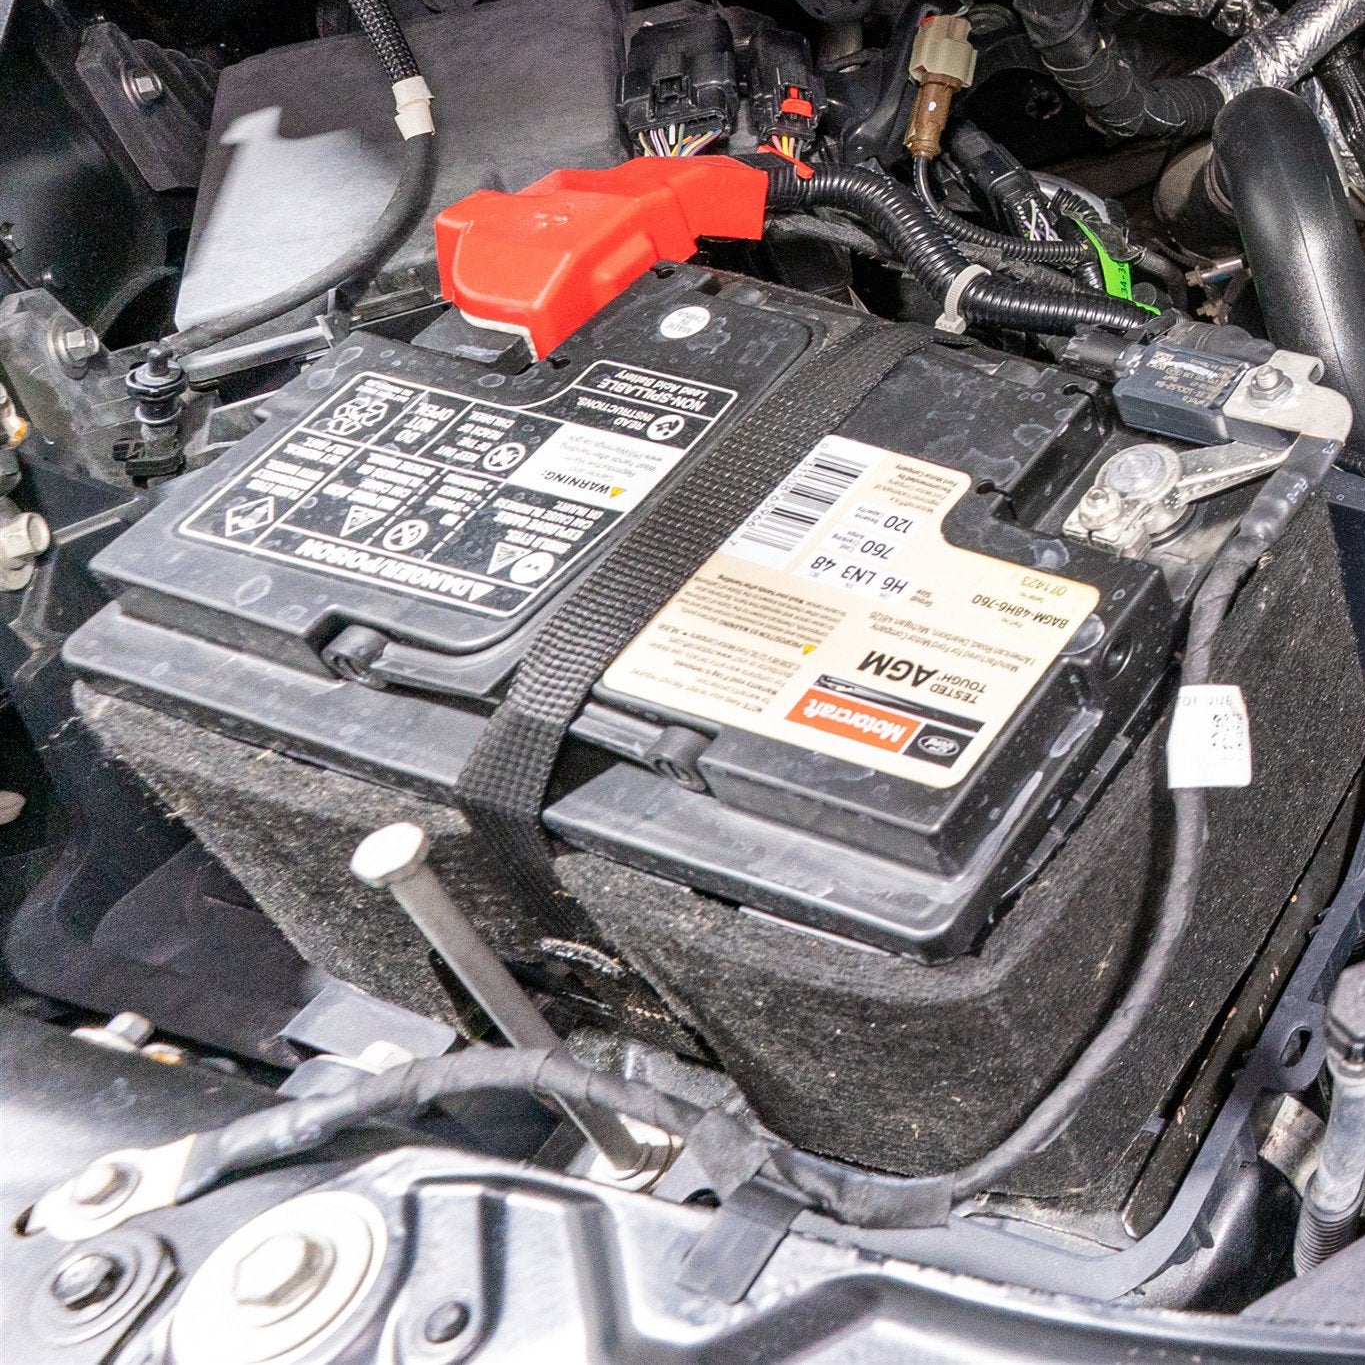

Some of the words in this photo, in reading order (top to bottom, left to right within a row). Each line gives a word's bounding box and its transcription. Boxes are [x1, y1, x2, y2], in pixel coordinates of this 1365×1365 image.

[613, 369, 658, 386] Battery
[596, 378, 706, 411] NON-SPILLABLE
[654, 381, 681, 392] Acid
[678, 387, 709, 399] Lead
[411, 402, 456, 421] OPEN.
[574, 397, 655, 421] INSTRUCTIONS.
[403, 416, 439, 432] NOT
[457, 423, 475, 432] OF
[466, 411, 516, 428] CHILDREN.
[612, 417, 646, 430] READ
[393, 429, 422, 443] DO
[469, 426, 505, 440] REACH
[433, 445, 458, 456] OUT
[456, 437, 479, 447] THE
[475, 442, 493, 451] OF
[453, 450, 481, 462] KEEP
[538, 471, 611, 493] WARNING:
[492, 498, 546, 517] BLINDNESS
[551, 501, 590, 516] INJURY.
[586, 510, 604, 519] OR
[493, 511, 532, 527] GASES
[541, 511, 575, 524] CAUSE
[571, 518, 595, 529] CAN
[881, 513, 915, 534] 120
[501, 530, 537, 545] EYES.
[524, 519, 585, 540] EXPLOSIVE
[530, 537, 572, 554] SHIELD
[857, 538, 896, 559] 760
[293, 539, 477, 596] DANGER/POISON
[808, 554, 839, 573] 48
[838, 564, 877, 585] LN3
[878, 575, 909, 594] H6
[1018, 574, 1068, 596] 071423
[866, 610, 895, 625] 48126
[970, 593, 1070, 629] BAGM-48H6-760
[868, 621, 910, 640] Company
[890, 616, 932, 635] Michigan
[905, 633, 932, 647] Motor
[928, 640, 952, 653] Ford
[947, 645, 964, 656] for
[989, 646, 1032, 666] American
[855, 648, 940, 689] AGM
[960, 649, 1021, 673] Manufactured
[927, 682, 980, 704] TESTED
[797, 697, 908, 743] Motorcraft
